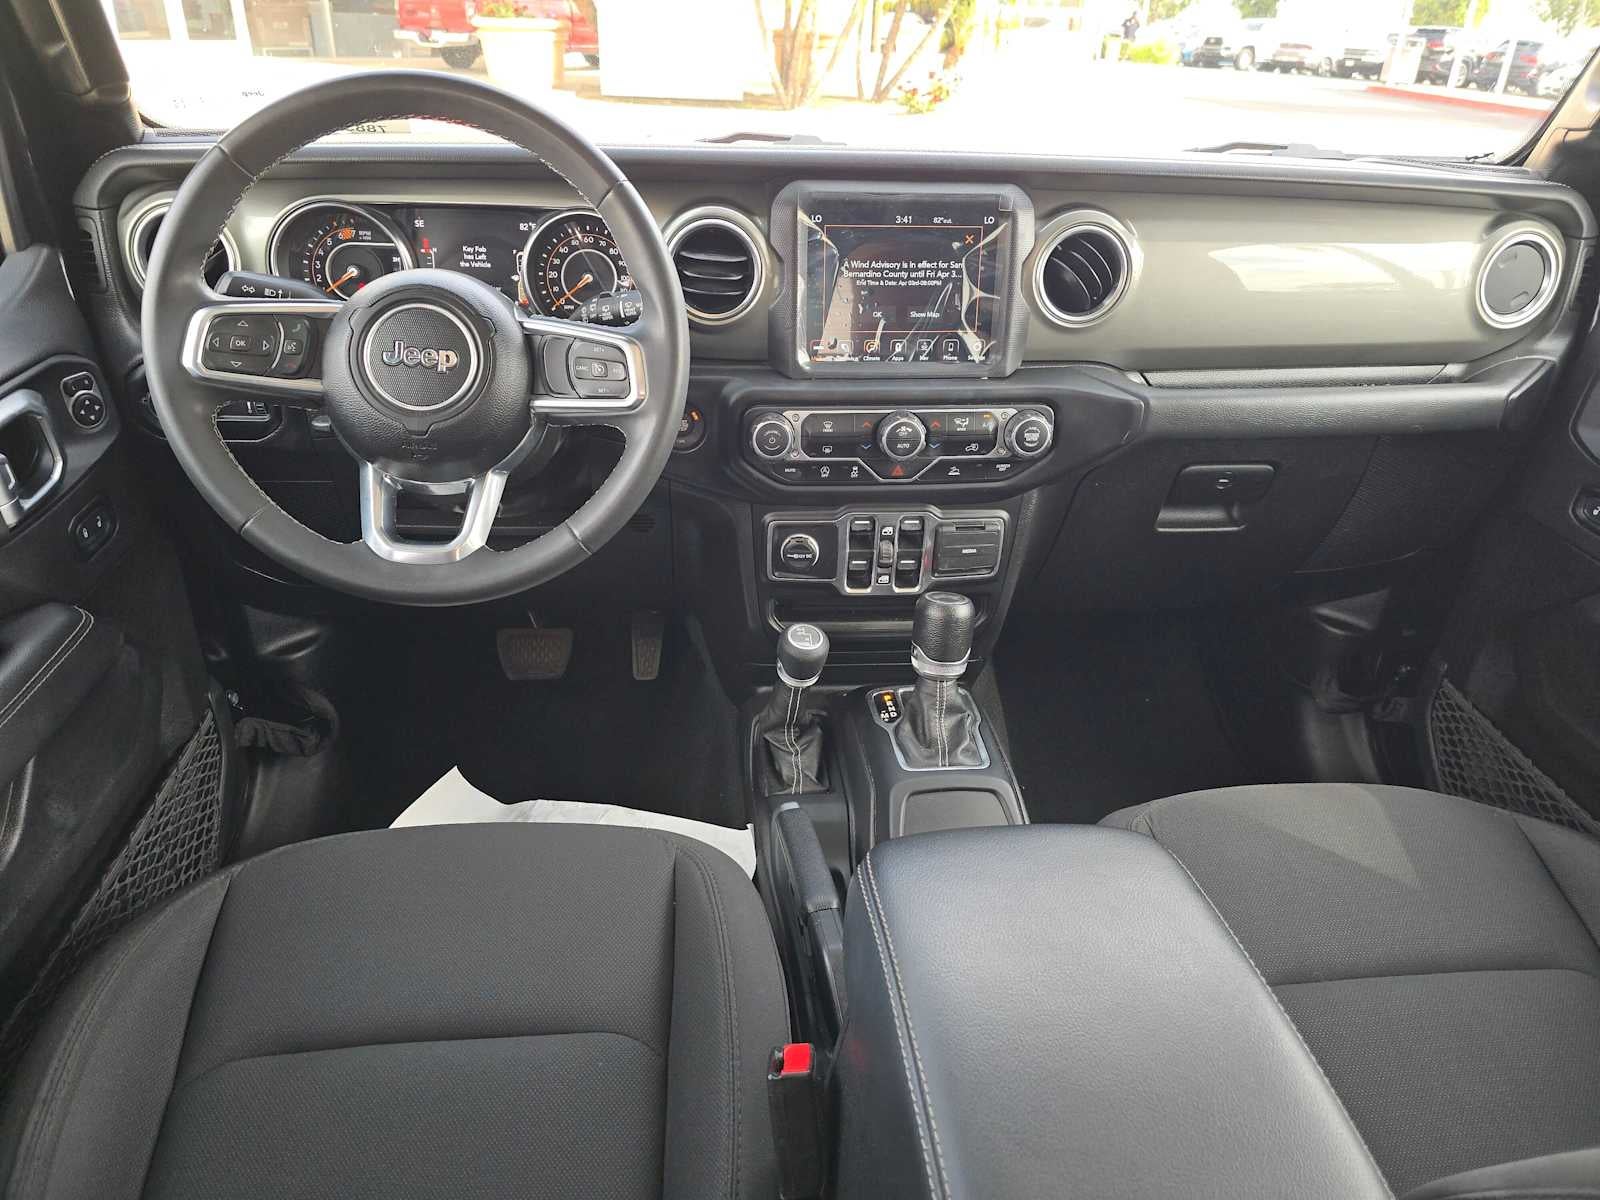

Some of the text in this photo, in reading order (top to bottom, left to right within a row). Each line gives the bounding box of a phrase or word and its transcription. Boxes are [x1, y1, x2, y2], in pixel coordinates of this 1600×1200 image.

[414, 219, 425, 228] SE
[895, 215, 912, 224] 3:41
[984, 216, 995, 225] LO
[326, 238, 333, 246] 5
[583, 236, 594, 244] 60
[462, 244, 487, 253] Key Fob
[558, 246, 569, 254] 40
[608, 247, 619, 255] 80
[463, 252, 487, 260] has Left
[314, 260, 321, 269] 3
[459, 260, 492, 268] the Vehicle
[843, 260, 963, 270] A Wind Advisory is in effect for San
[316, 274, 322, 282] 2
[548, 271, 558, 279] 20
[843, 270, 882, 278] Bernardino
[883, 269, 909, 280] County
[910, 269, 925, 278] until
[926, 270, 936, 278] Fri
[936, 270, 950, 280] Apr
[898, 280, 908, 288] Apr
[872, 310, 883, 318] OK
[910, 310, 941, 320] Show Map
[234, 339, 247, 347] OK
[382, 340, 458, 373] Jeep
[891, 355, 904, 363] Apps
[942, 354, 958, 362] Phone
[888, 705, 897, 713] N
[889, 711, 898, 719] D
